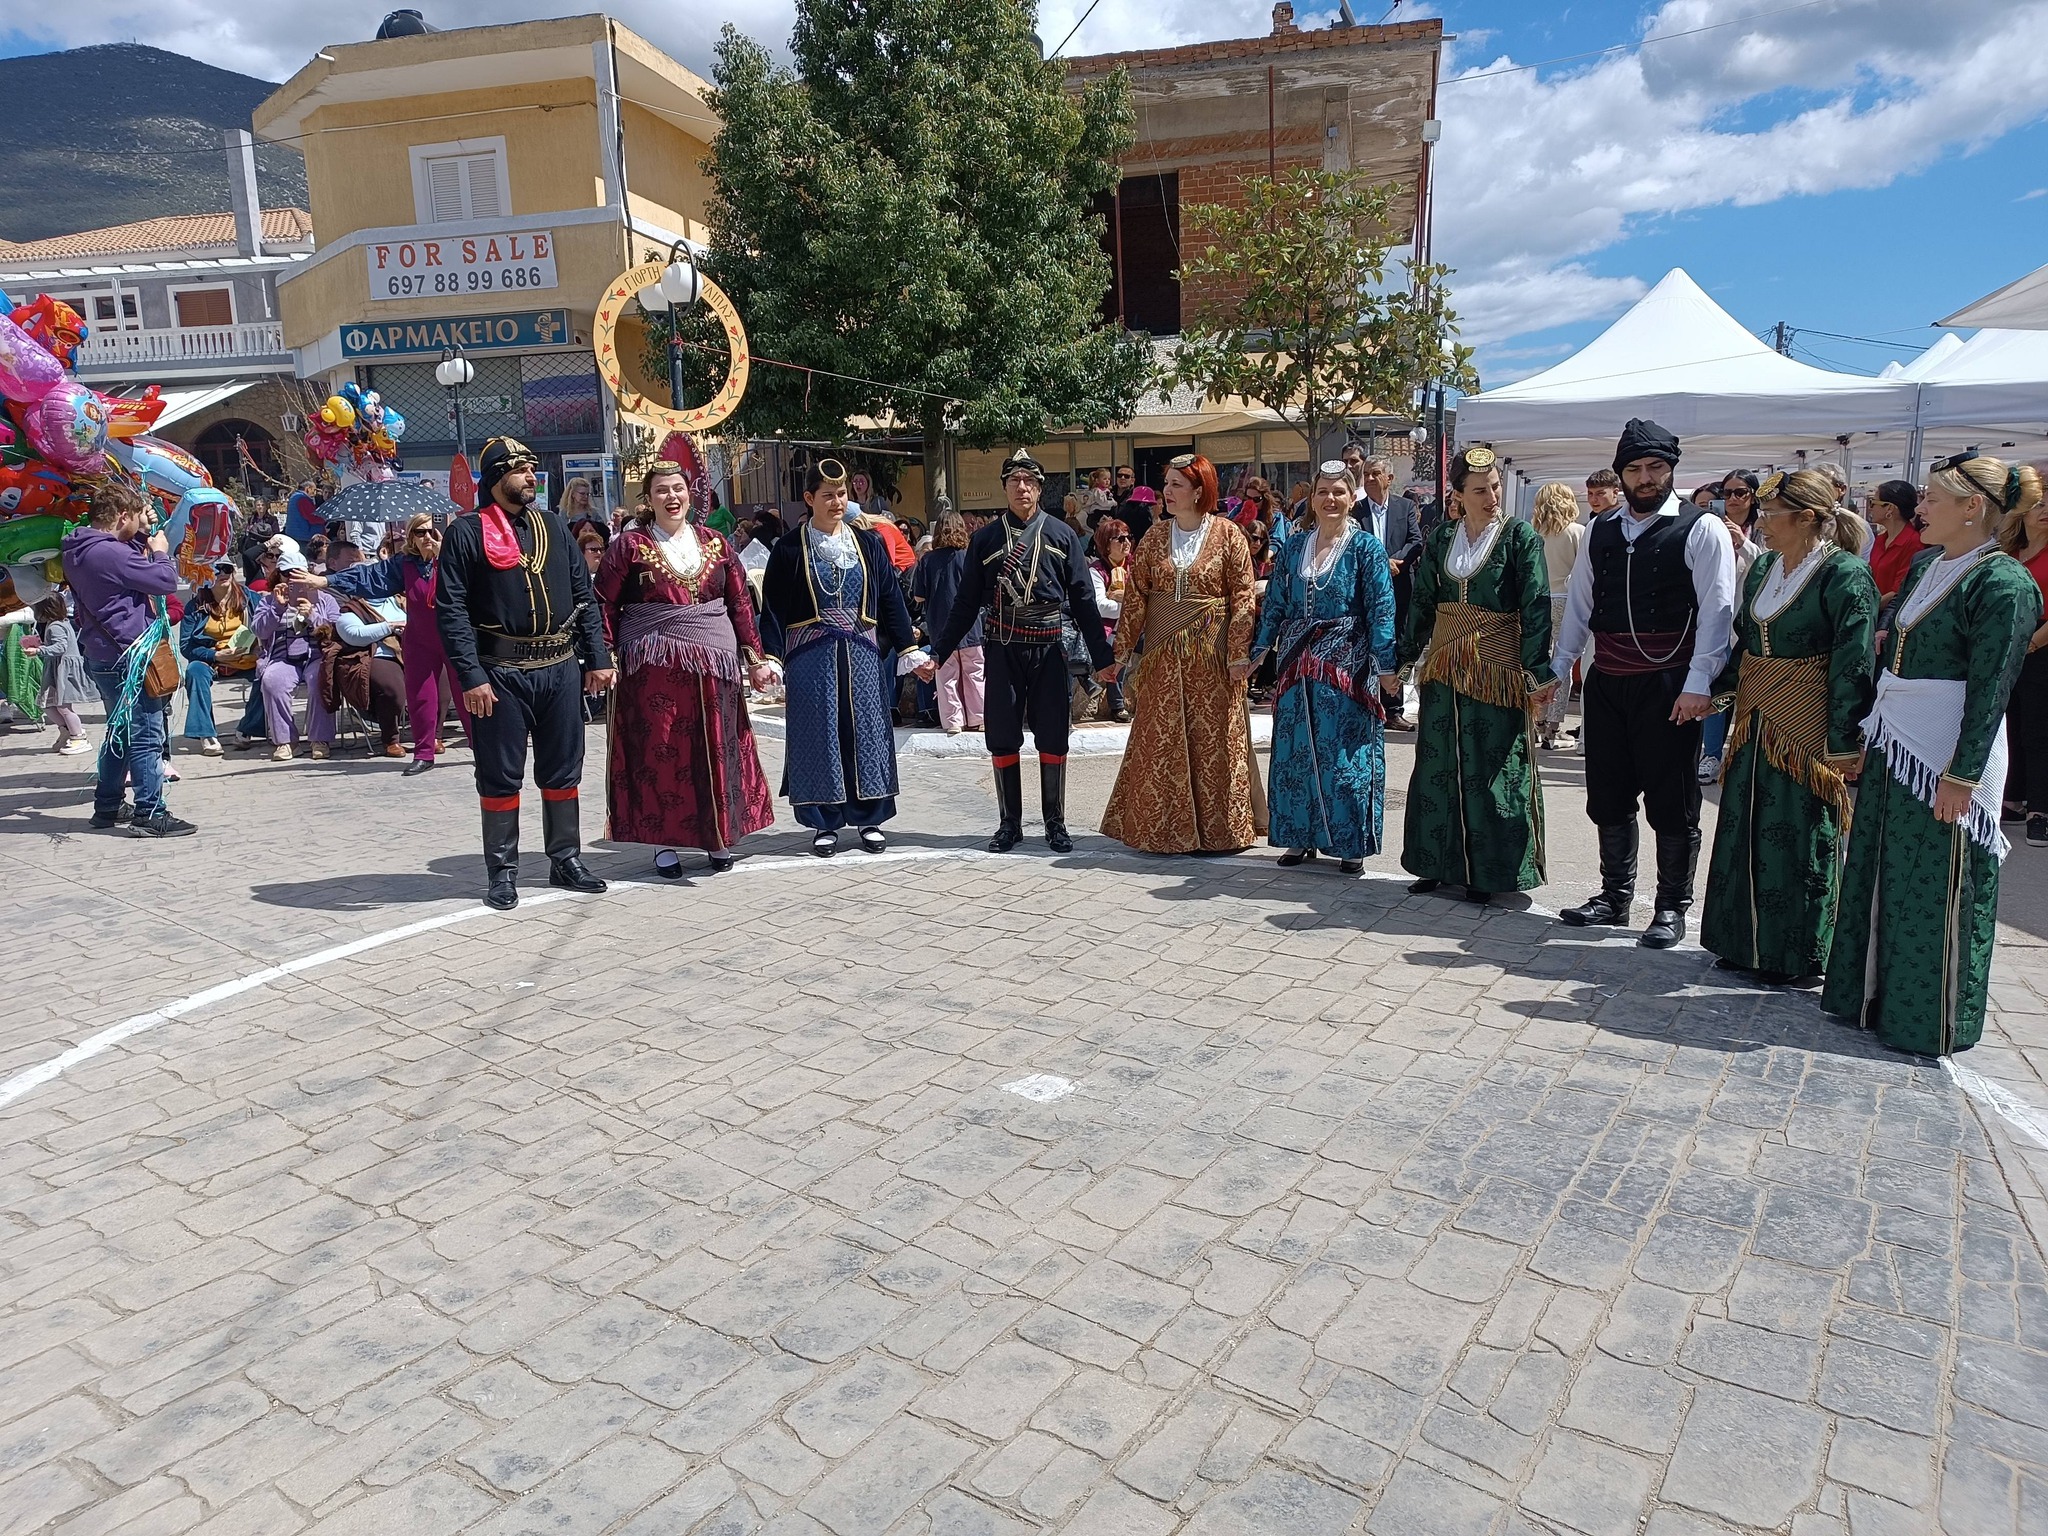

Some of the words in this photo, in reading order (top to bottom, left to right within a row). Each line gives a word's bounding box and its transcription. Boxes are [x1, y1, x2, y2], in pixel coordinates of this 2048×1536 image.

[375, 242, 443, 269] FOR
[462, 234, 549, 264] SALE
[388, 274, 426, 295] 697
[434, 272, 459, 292] 88
[467, 270, 493, 290] 99
[501, 266, 541, 288] 686
[624, 265, 661, 291] ΓΙΟΡΤΗ
[702, 279, 735, 322] ΥΛΙΠΑΣ
[345, 318, 519, 351] ΦΑΡΜΑΚΕΙΟ
